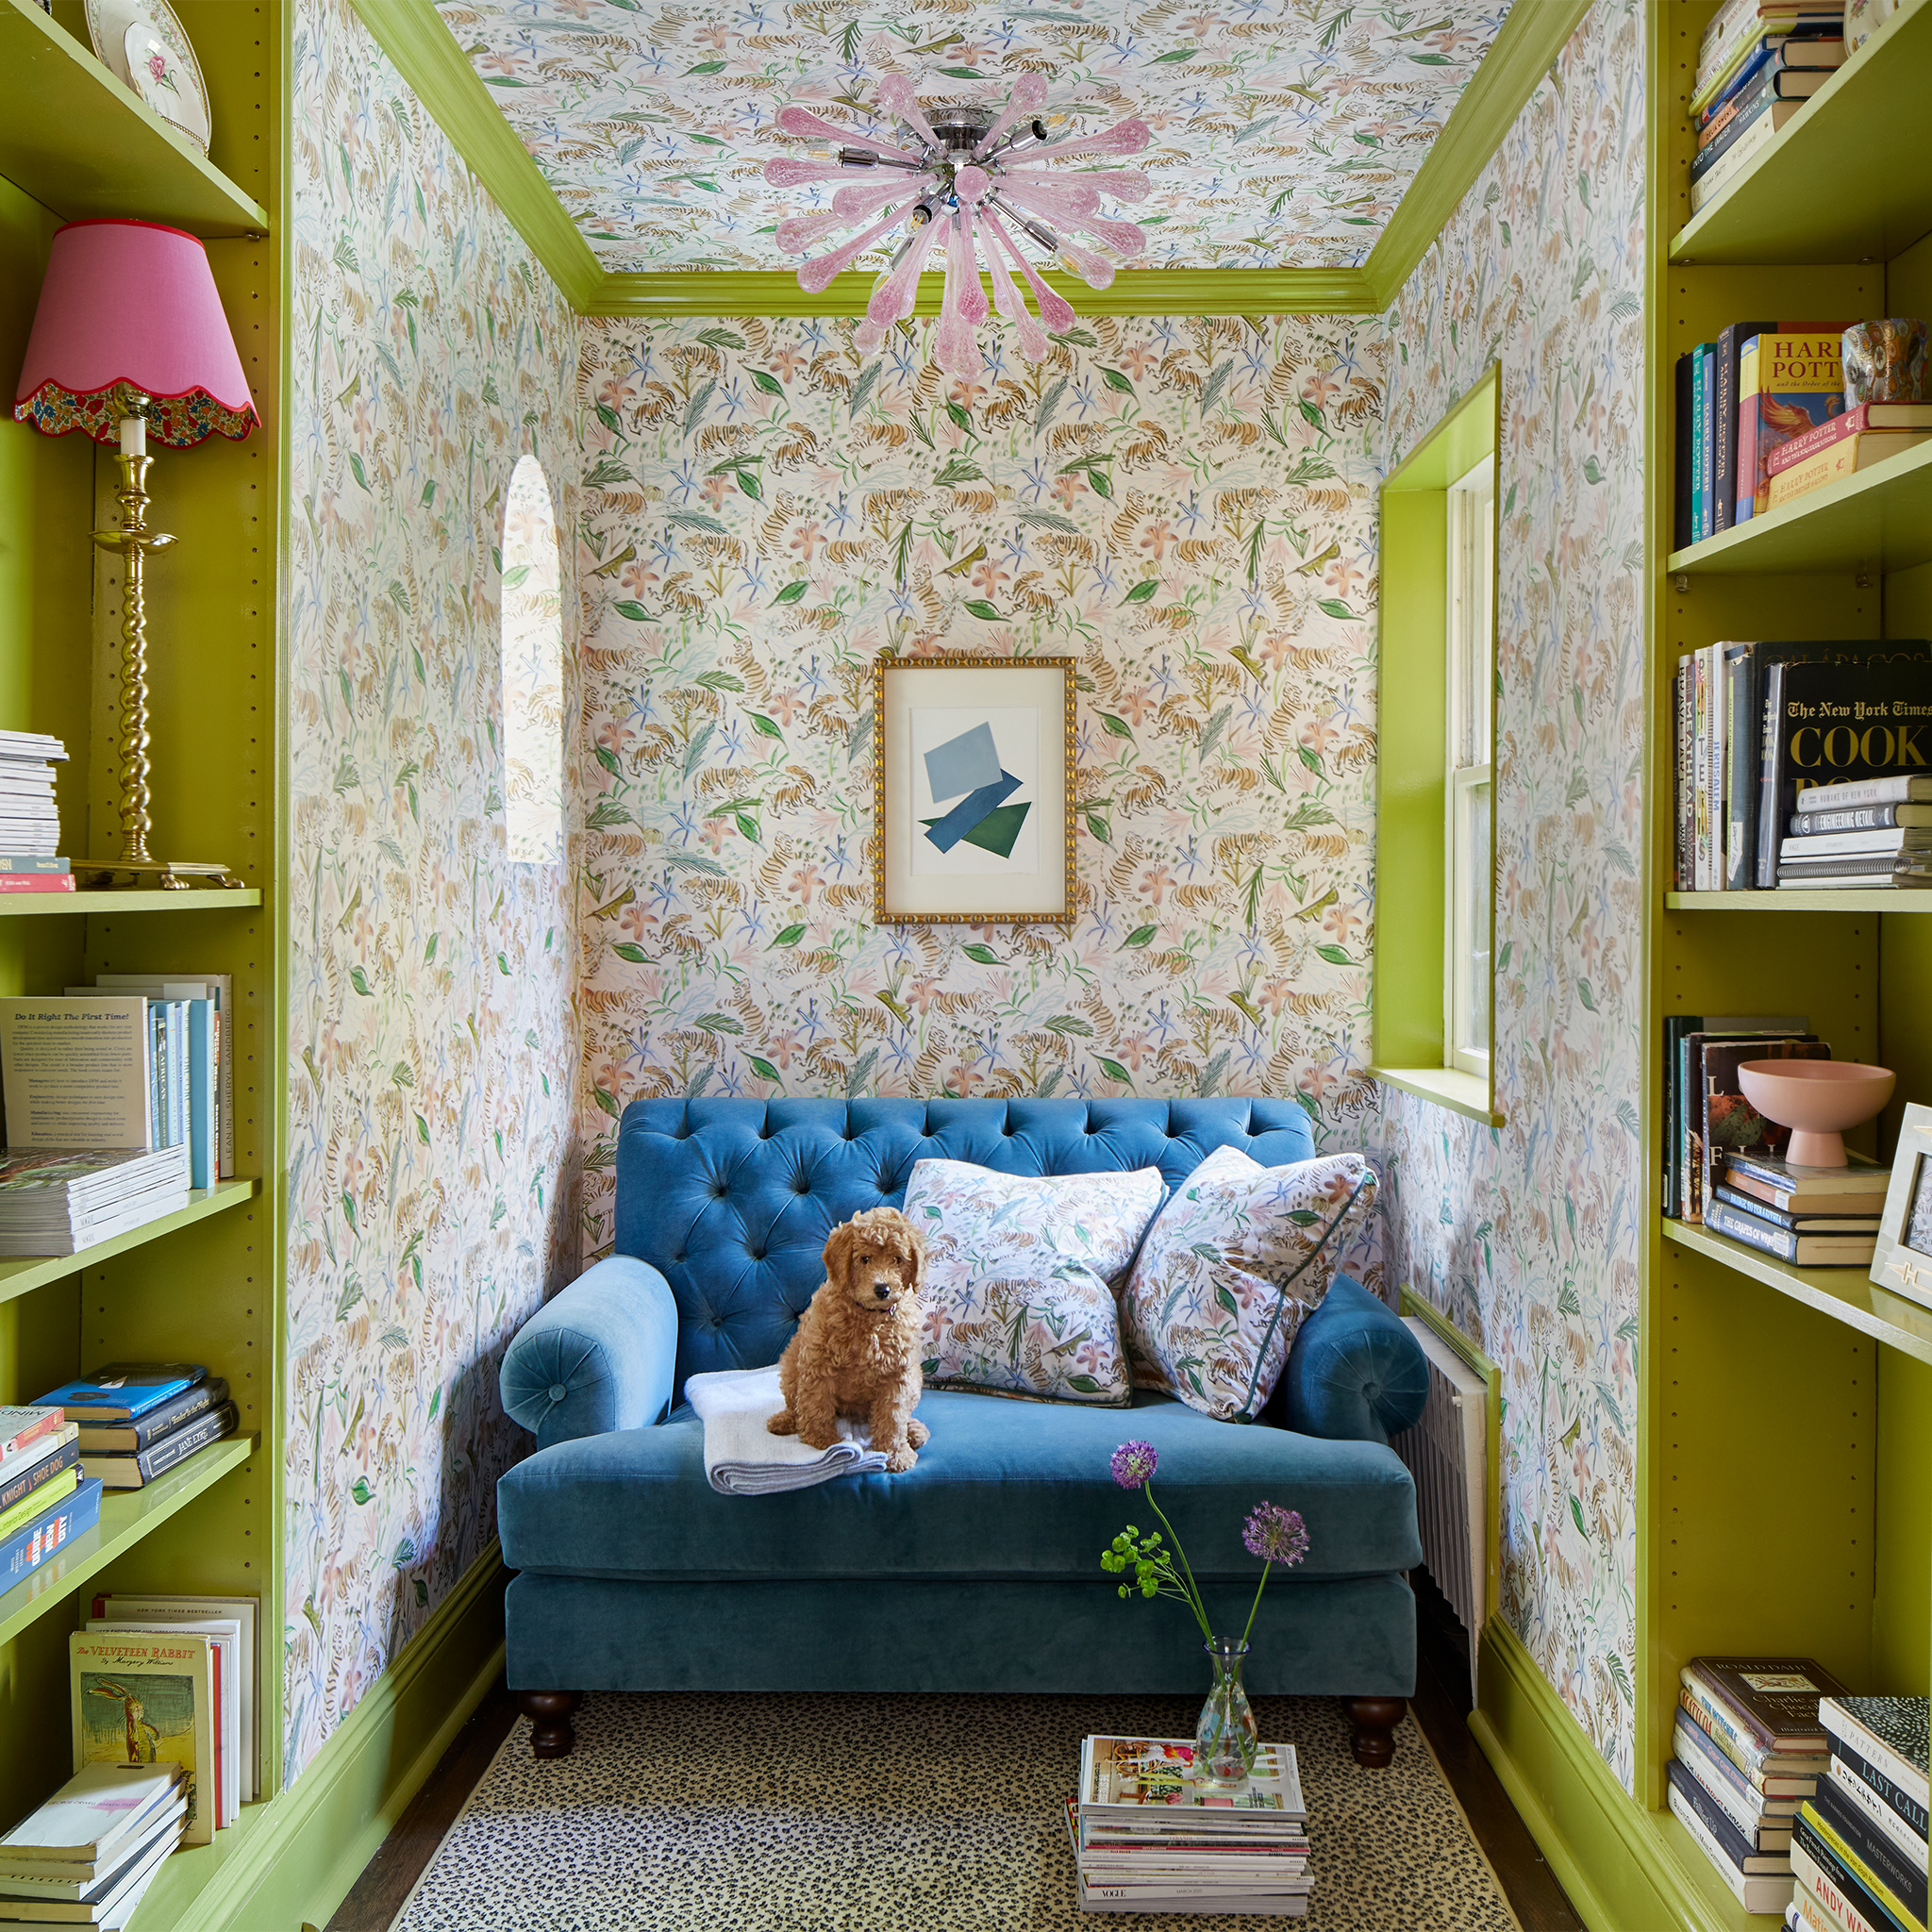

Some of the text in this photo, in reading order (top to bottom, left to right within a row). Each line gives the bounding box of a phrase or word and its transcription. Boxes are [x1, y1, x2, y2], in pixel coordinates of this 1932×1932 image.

[1739, 99, 1760, 125] HAWKINS
[1704, 144, 1714, 157] THE
[1714, 124, 1731, 148] WATER
[1781, 422, 1837, 457] HARRY POTTER
[1780, 462, 1829, 493] HARRY POTTER
[1788, 700, 1932, 722] The New York Times
[1686, 700, 1694, 819] MEATHEAD
[1790, 724, 1932, 768] COOK
[1820, 788, 1877, 803] HUMANS OF NEW YORK
[1855, 808, 1875, 827] RETAIL
[38, 1013, 60, 1022] Right
[225, 1118, 232, 1130] IN
[1724, 1215, 1735, 1229] THE
[1734, 1218, 1754, 1237] GRAPES
[1753, 1228, 1760, 1241] OF
[171, 1410, 187, 1424] Tender
[178, 1427, 208, 1456] JANE EYRE
[1, 1455, 63, 1507] KNIGHT SHOE DOG
[2, 1507, 33, 1528] Interior Design
[58, 1515, 68, 1543] CITY
[31, 1526, 42, 1567] GUIDE
[44, 1523, 55, 1554] NEW
[76, 1645, 195, 1659] The VELVETEEN RABBIT
[112, 1656, 144, 1667] Margery
[146, 1657, 174, 1666] Williams
[1682, 1691, 1713, 1739] MATILDA
[1752, 1694, 1806, 1705] Charlie
[1701, 1695, 1712, 1715] THE
[1712, 1707, 1738, 1743] WITCHES
[1849, 1731, 1890, 1769] PATTERN
[1686, 1760, 1746, 1837] THE LEAN PRODUCT PLAYBOOK
[1861, 1760, 1892, 1799] LAST
[1894, 1791, 1928, 1832] CALL
[1799, 1826, 1809, 1839] Great
[1808, 1835, 1821, 1852] French
[1820, 1848, 1836, 1871] Paintings
[1835, 1865, 1845, 1882] from
[1806, 1842, 1817, 1861] Barnes
[1816, 1857, 1838, 1885] Foundation
[1817, 1821, 1840, 1848] Masterpieces
[1839, 1842, 1844, 1852] in
[1850, 1854, 1858, 1868] Van
[1857, 1864, 1869, 1880] Gogh
[1868, 1874, 1885, 1897] Museum
[1866, 1839, 1913, 1893] MASTERWORKS
[1102, 1889, 1126, 1898] VOGUE
[1816, 1875, 1843, 1919] ANDY
